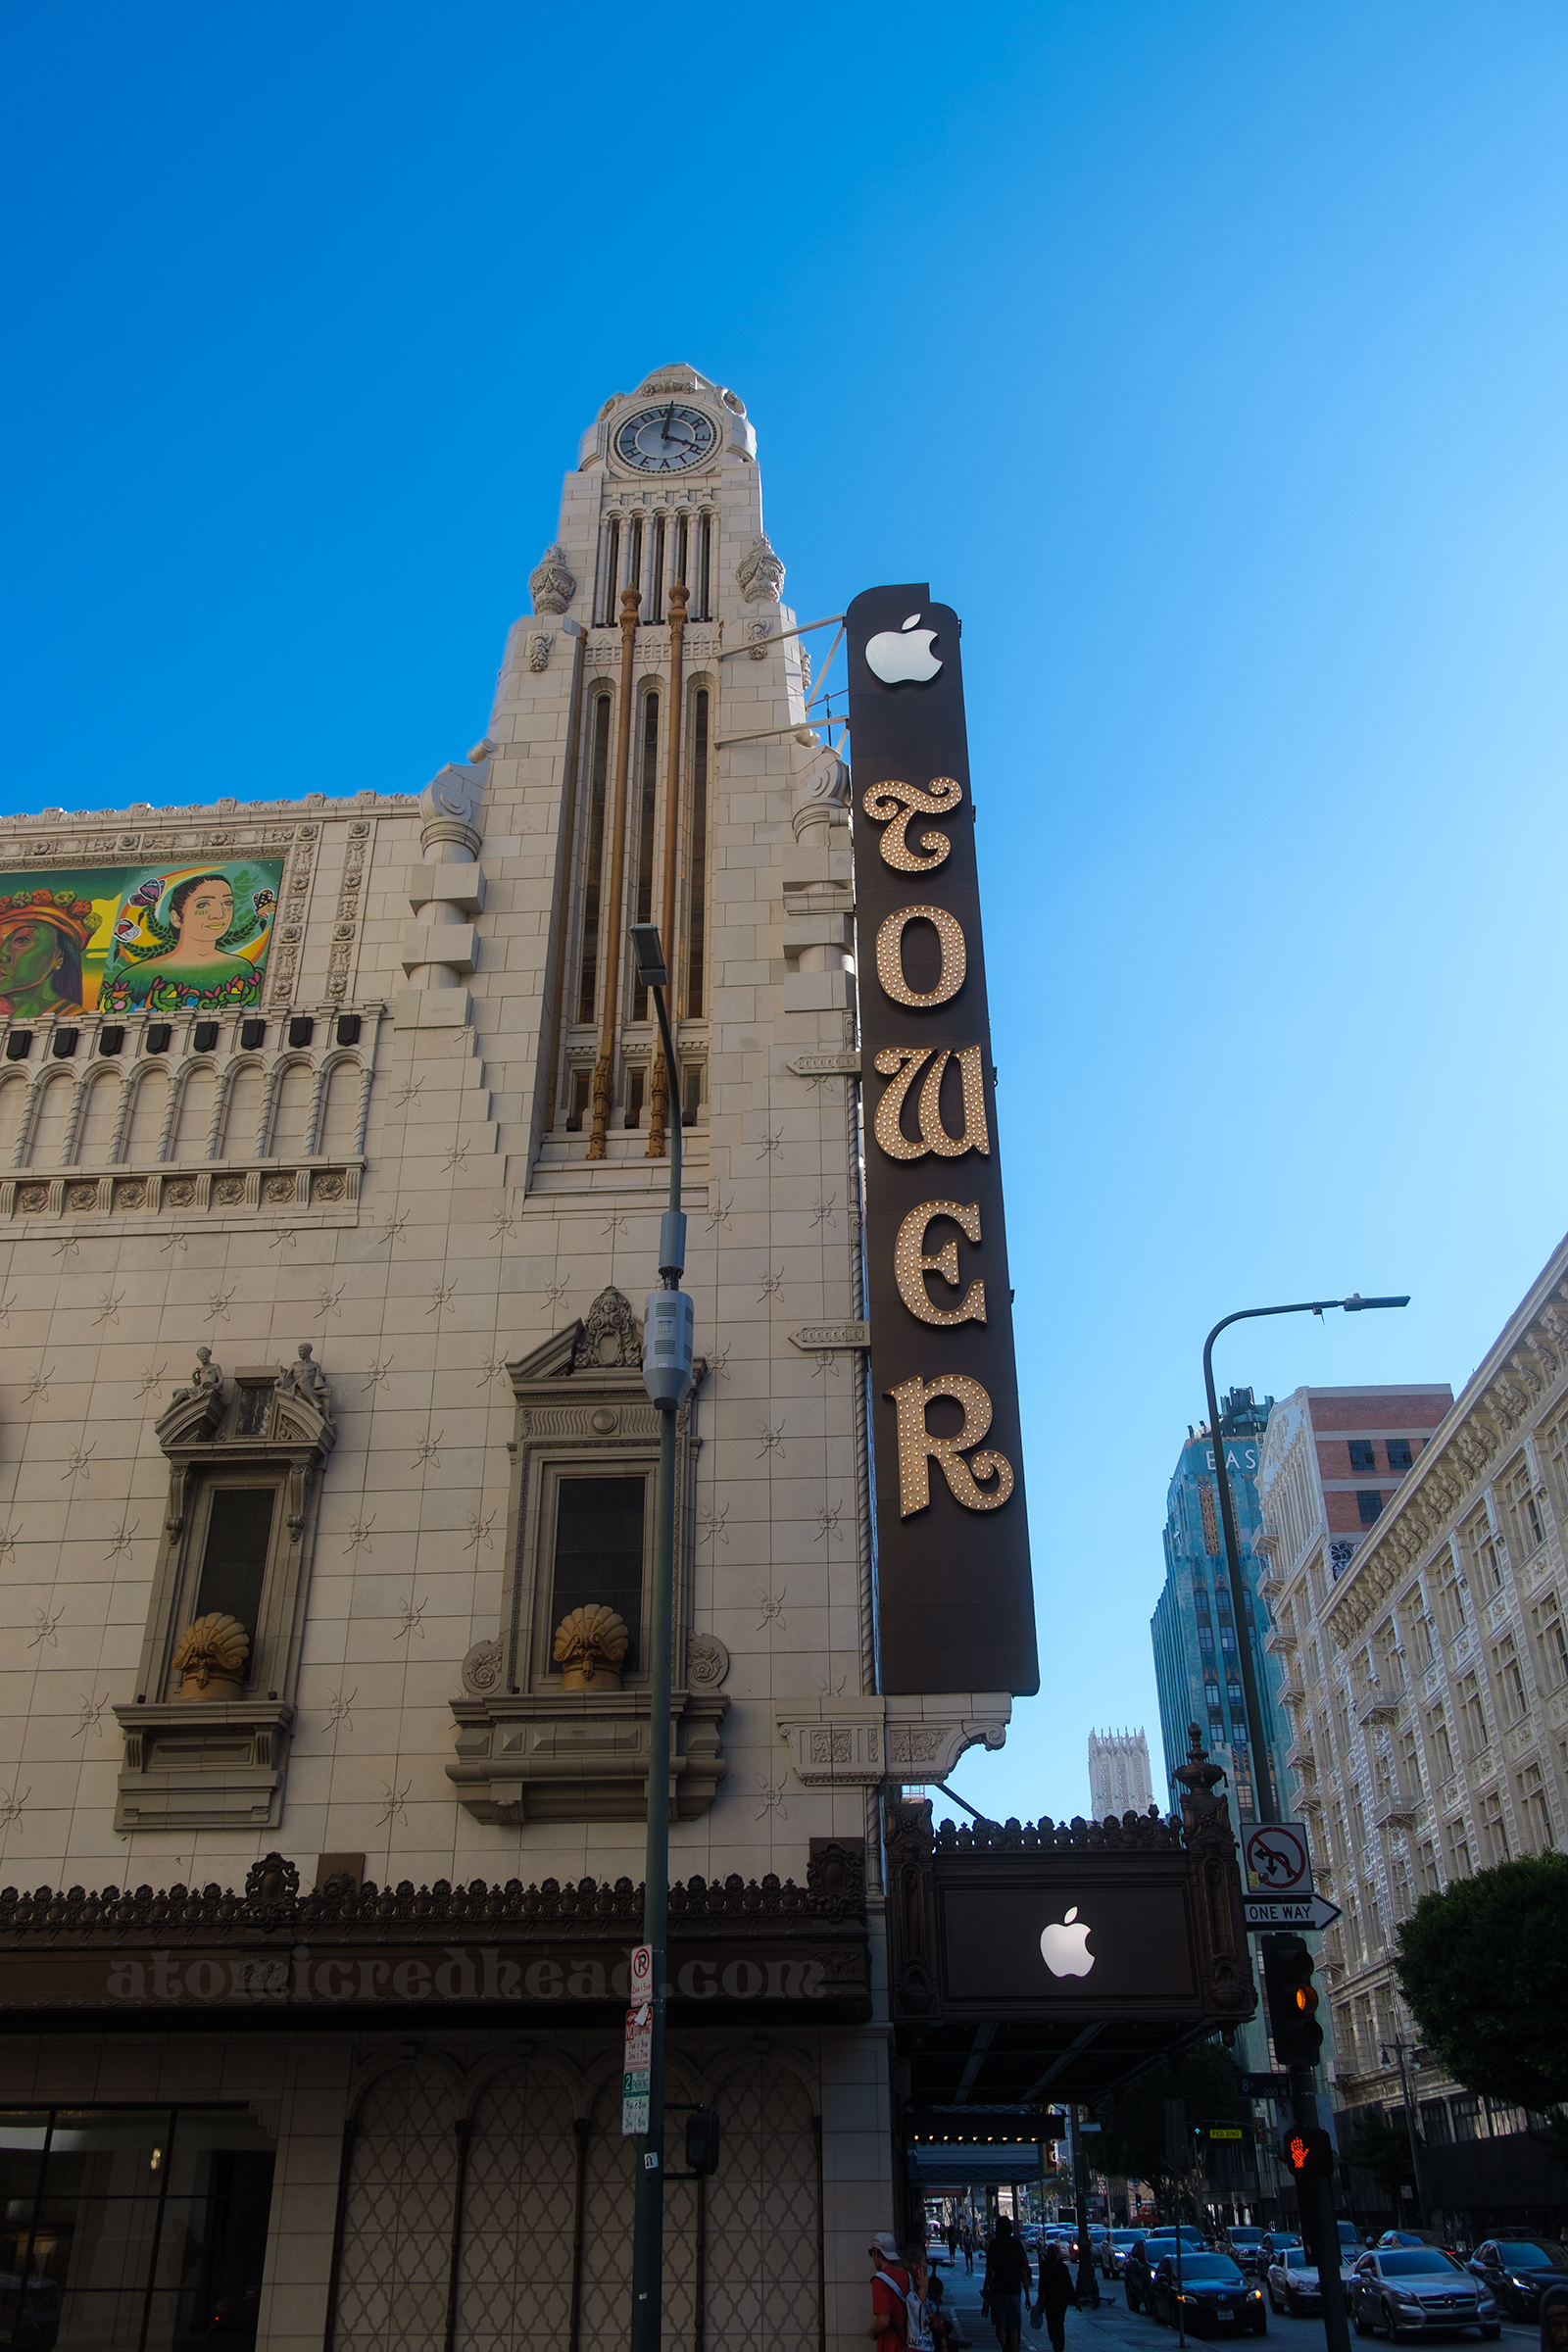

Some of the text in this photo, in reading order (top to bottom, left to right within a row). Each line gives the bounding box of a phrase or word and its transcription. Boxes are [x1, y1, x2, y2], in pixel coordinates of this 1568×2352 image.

[625, 407, 708, 431] TOWER
[619, 432, 711, 469] THEATRE
[862, 776, 1015, 1522] TOWER
[1250, 1905, 1311, 1920] ONE WAY
[626, 2024, 634, 2040] NO
[625, 2075, 631, 2090] 2
[632, 2079, 649, 2090] PARKING
[1278, 2075, 1287, 2084] St
[1263, 2087, 1288, 2097] 200 W
